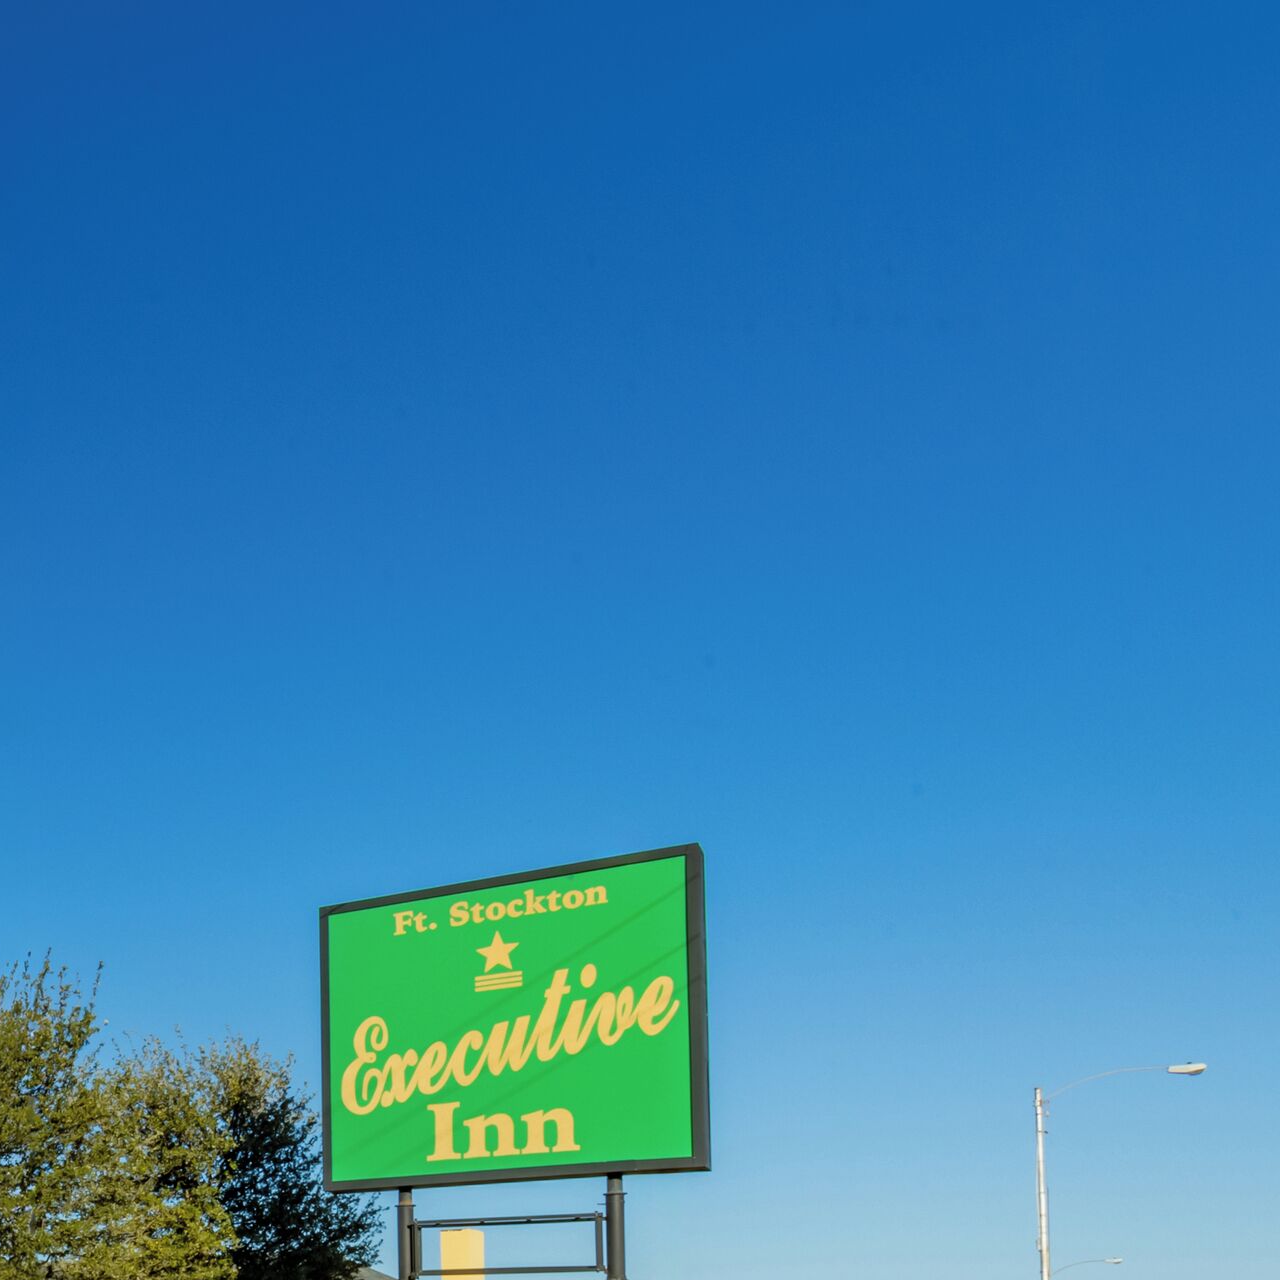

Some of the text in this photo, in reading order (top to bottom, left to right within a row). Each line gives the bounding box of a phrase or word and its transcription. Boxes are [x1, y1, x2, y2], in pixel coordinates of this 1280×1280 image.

[392, 885, 609, 936] Ft. Stockton
[341, 963, 681, 1116] Executive
[426, 1101, 581, 1162] Inn
